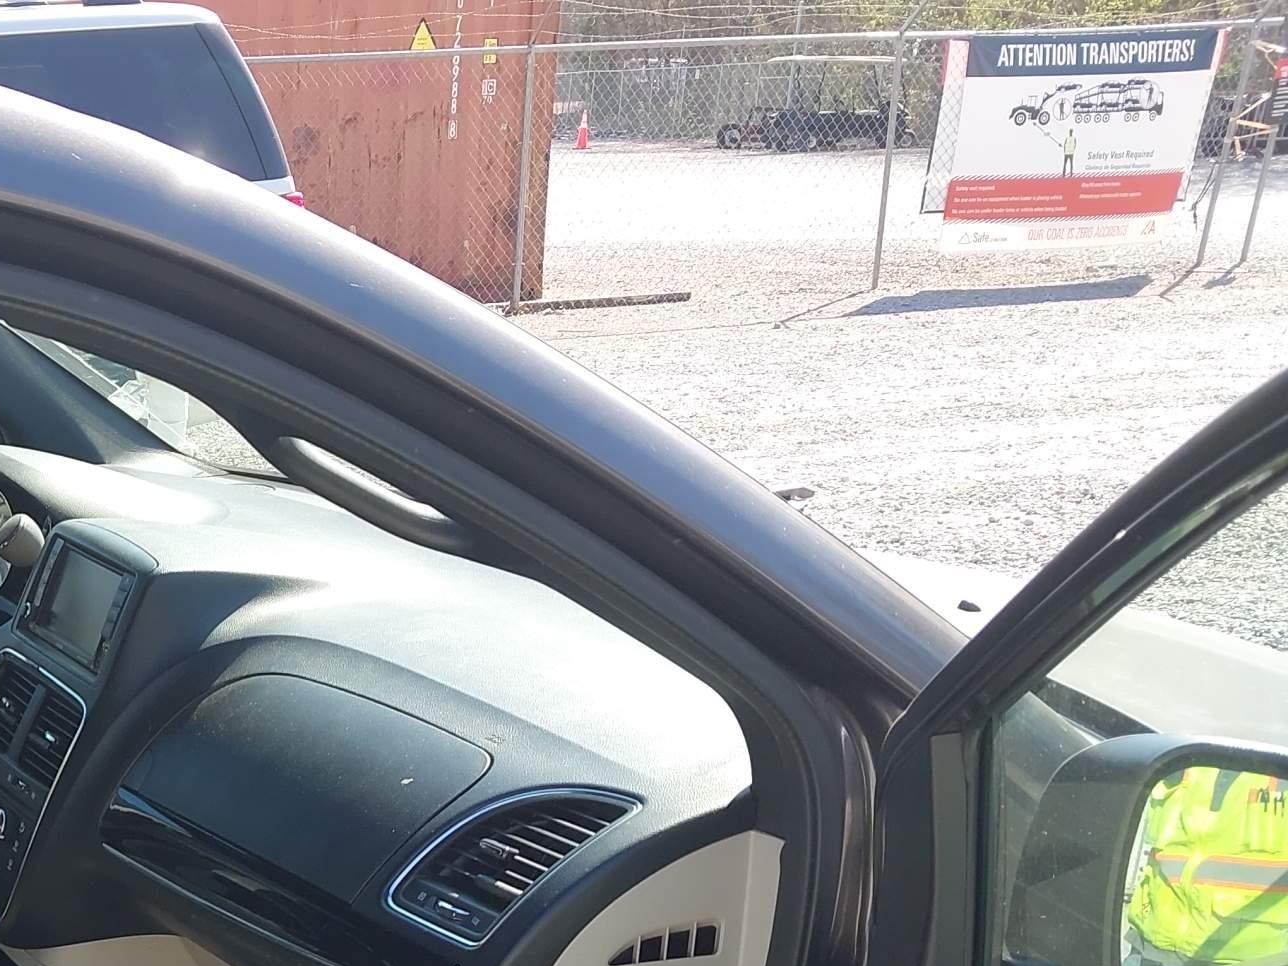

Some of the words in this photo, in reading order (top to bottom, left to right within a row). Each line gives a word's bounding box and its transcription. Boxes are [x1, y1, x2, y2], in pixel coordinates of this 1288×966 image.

[997, 43, 1077, 67] ATTENTION
[1080, 39, 1196, 65] TRANSPORTERS!
[1087, 151, 1109, 161] Safety
[1110, 151, 1125, 160] Vest
[1125, 149, 1155, 160] Required
